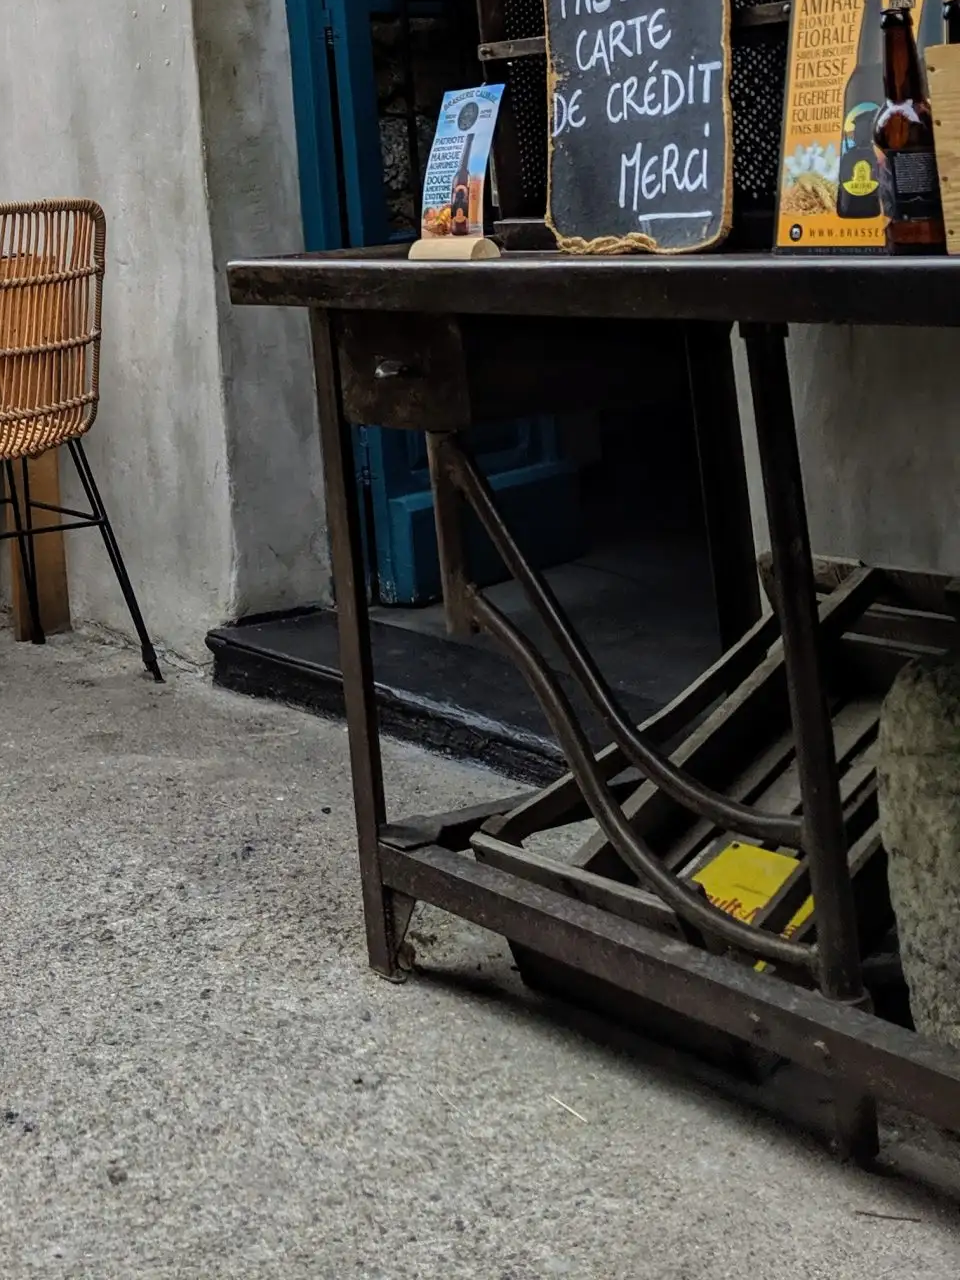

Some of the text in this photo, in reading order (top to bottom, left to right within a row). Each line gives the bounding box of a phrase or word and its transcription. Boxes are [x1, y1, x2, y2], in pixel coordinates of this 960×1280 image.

[798, 10, 858, 31] BLONDE ALE
[575, 7, 672, 76] CARTE
[796, 24, 856, 49] FLORALE
[795, 57, 849, 80] FINESSE
[551, 88, 587, 138] DE
[431, 151, 461, 162] MANGUE
[427, 175, 453, 185] DOUCE
